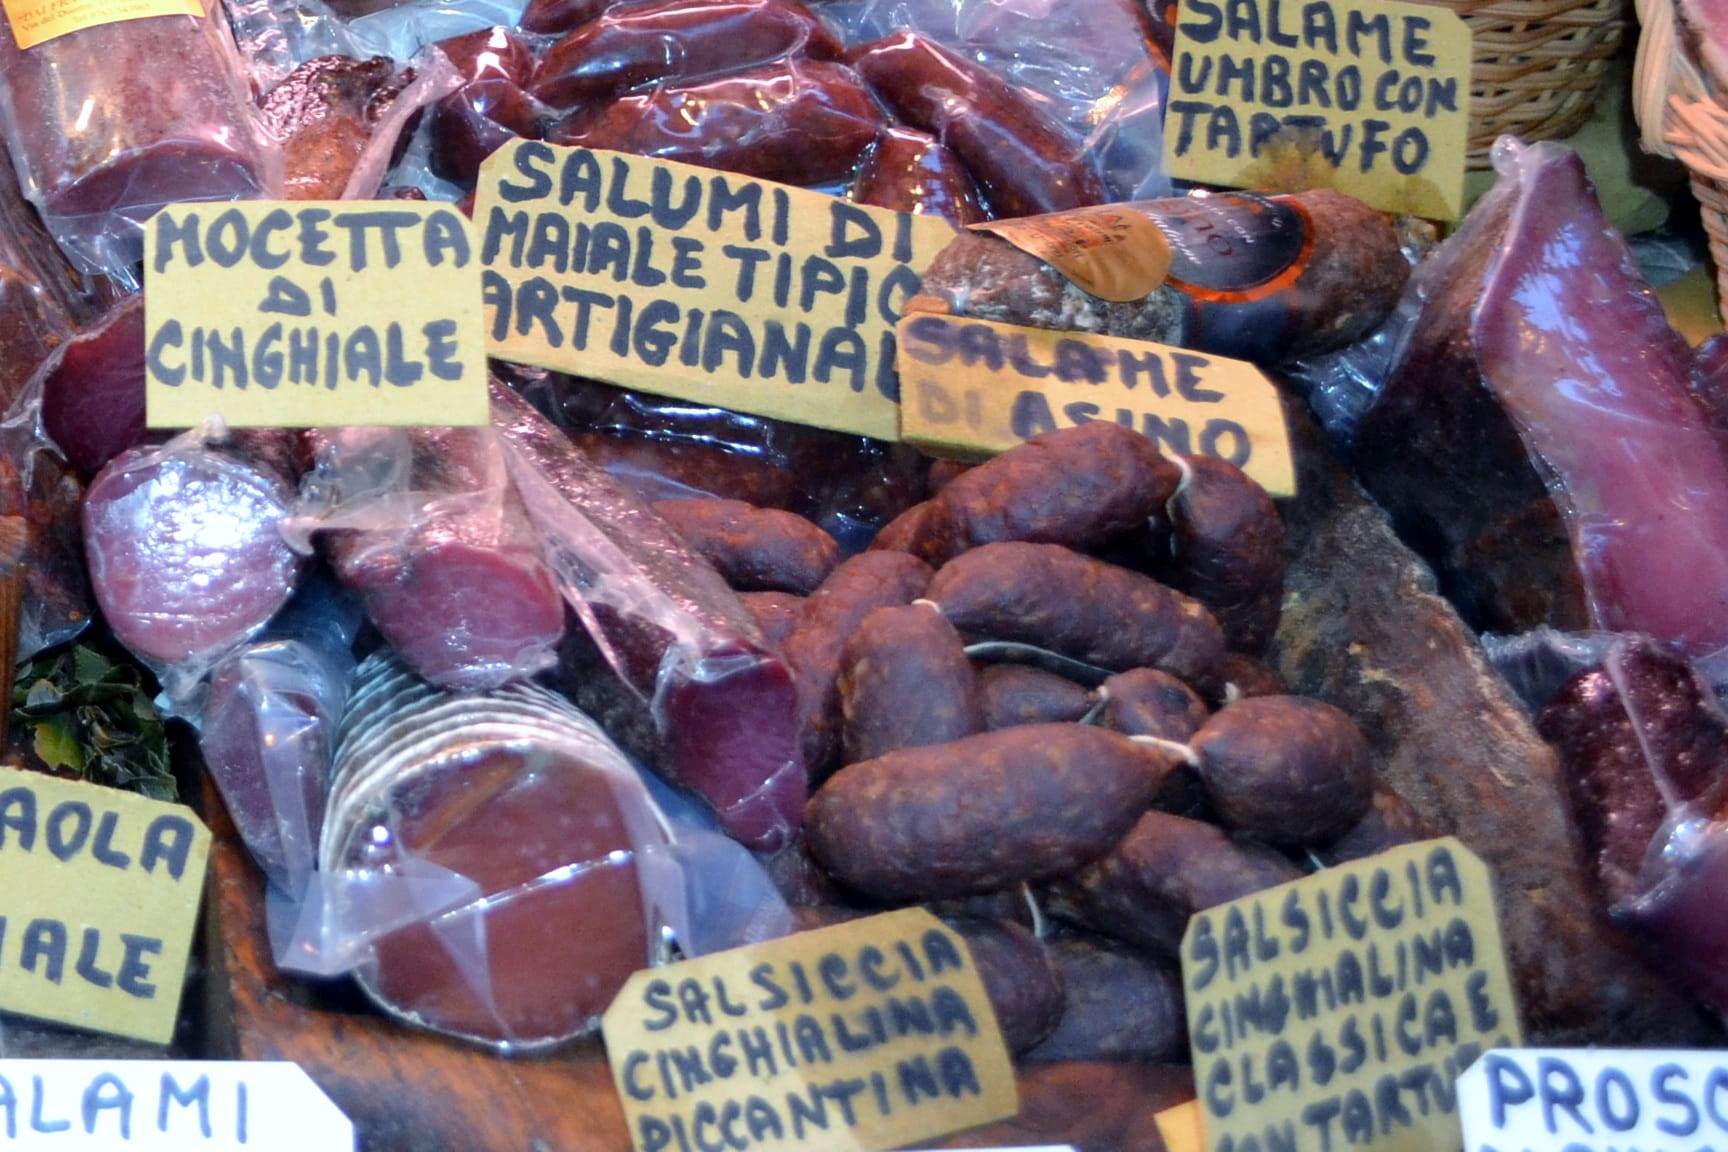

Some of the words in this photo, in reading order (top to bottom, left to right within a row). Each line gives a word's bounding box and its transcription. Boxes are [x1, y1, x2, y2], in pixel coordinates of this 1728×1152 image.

[1179, 51, 1363, 111] UMBRO
[1371, 69, 1458, 118] CON
[154, 209, 472, 274] MOCETTA
[481, 206, 707, 289] MAIALE
[499, 141, 788, 246] SALUMI
[824, 201, 912, 263] DI
[259, 277, 335, 316] DI
[147, 319, 463, 389] CINGHIALE
[904, 317, 1226, 402] SALAME
[915, 374, 981, 429] DI
[1191, 845, 1463, 991] SALSICCIA
[643, 928, 965, 1032] SALSICCIA
[1192, 917, 1476, 1054] CINGHIALINA
[624, 986, 978, 1102] CINGHIALINA
[1205, 989, 1456, 1117] CLASSICA
[1465, 969, 1499, 1034] E
[1301, 1035, 1512, 1152] TARTU
[637, 1048, 981, 1152] PICCANTINA
